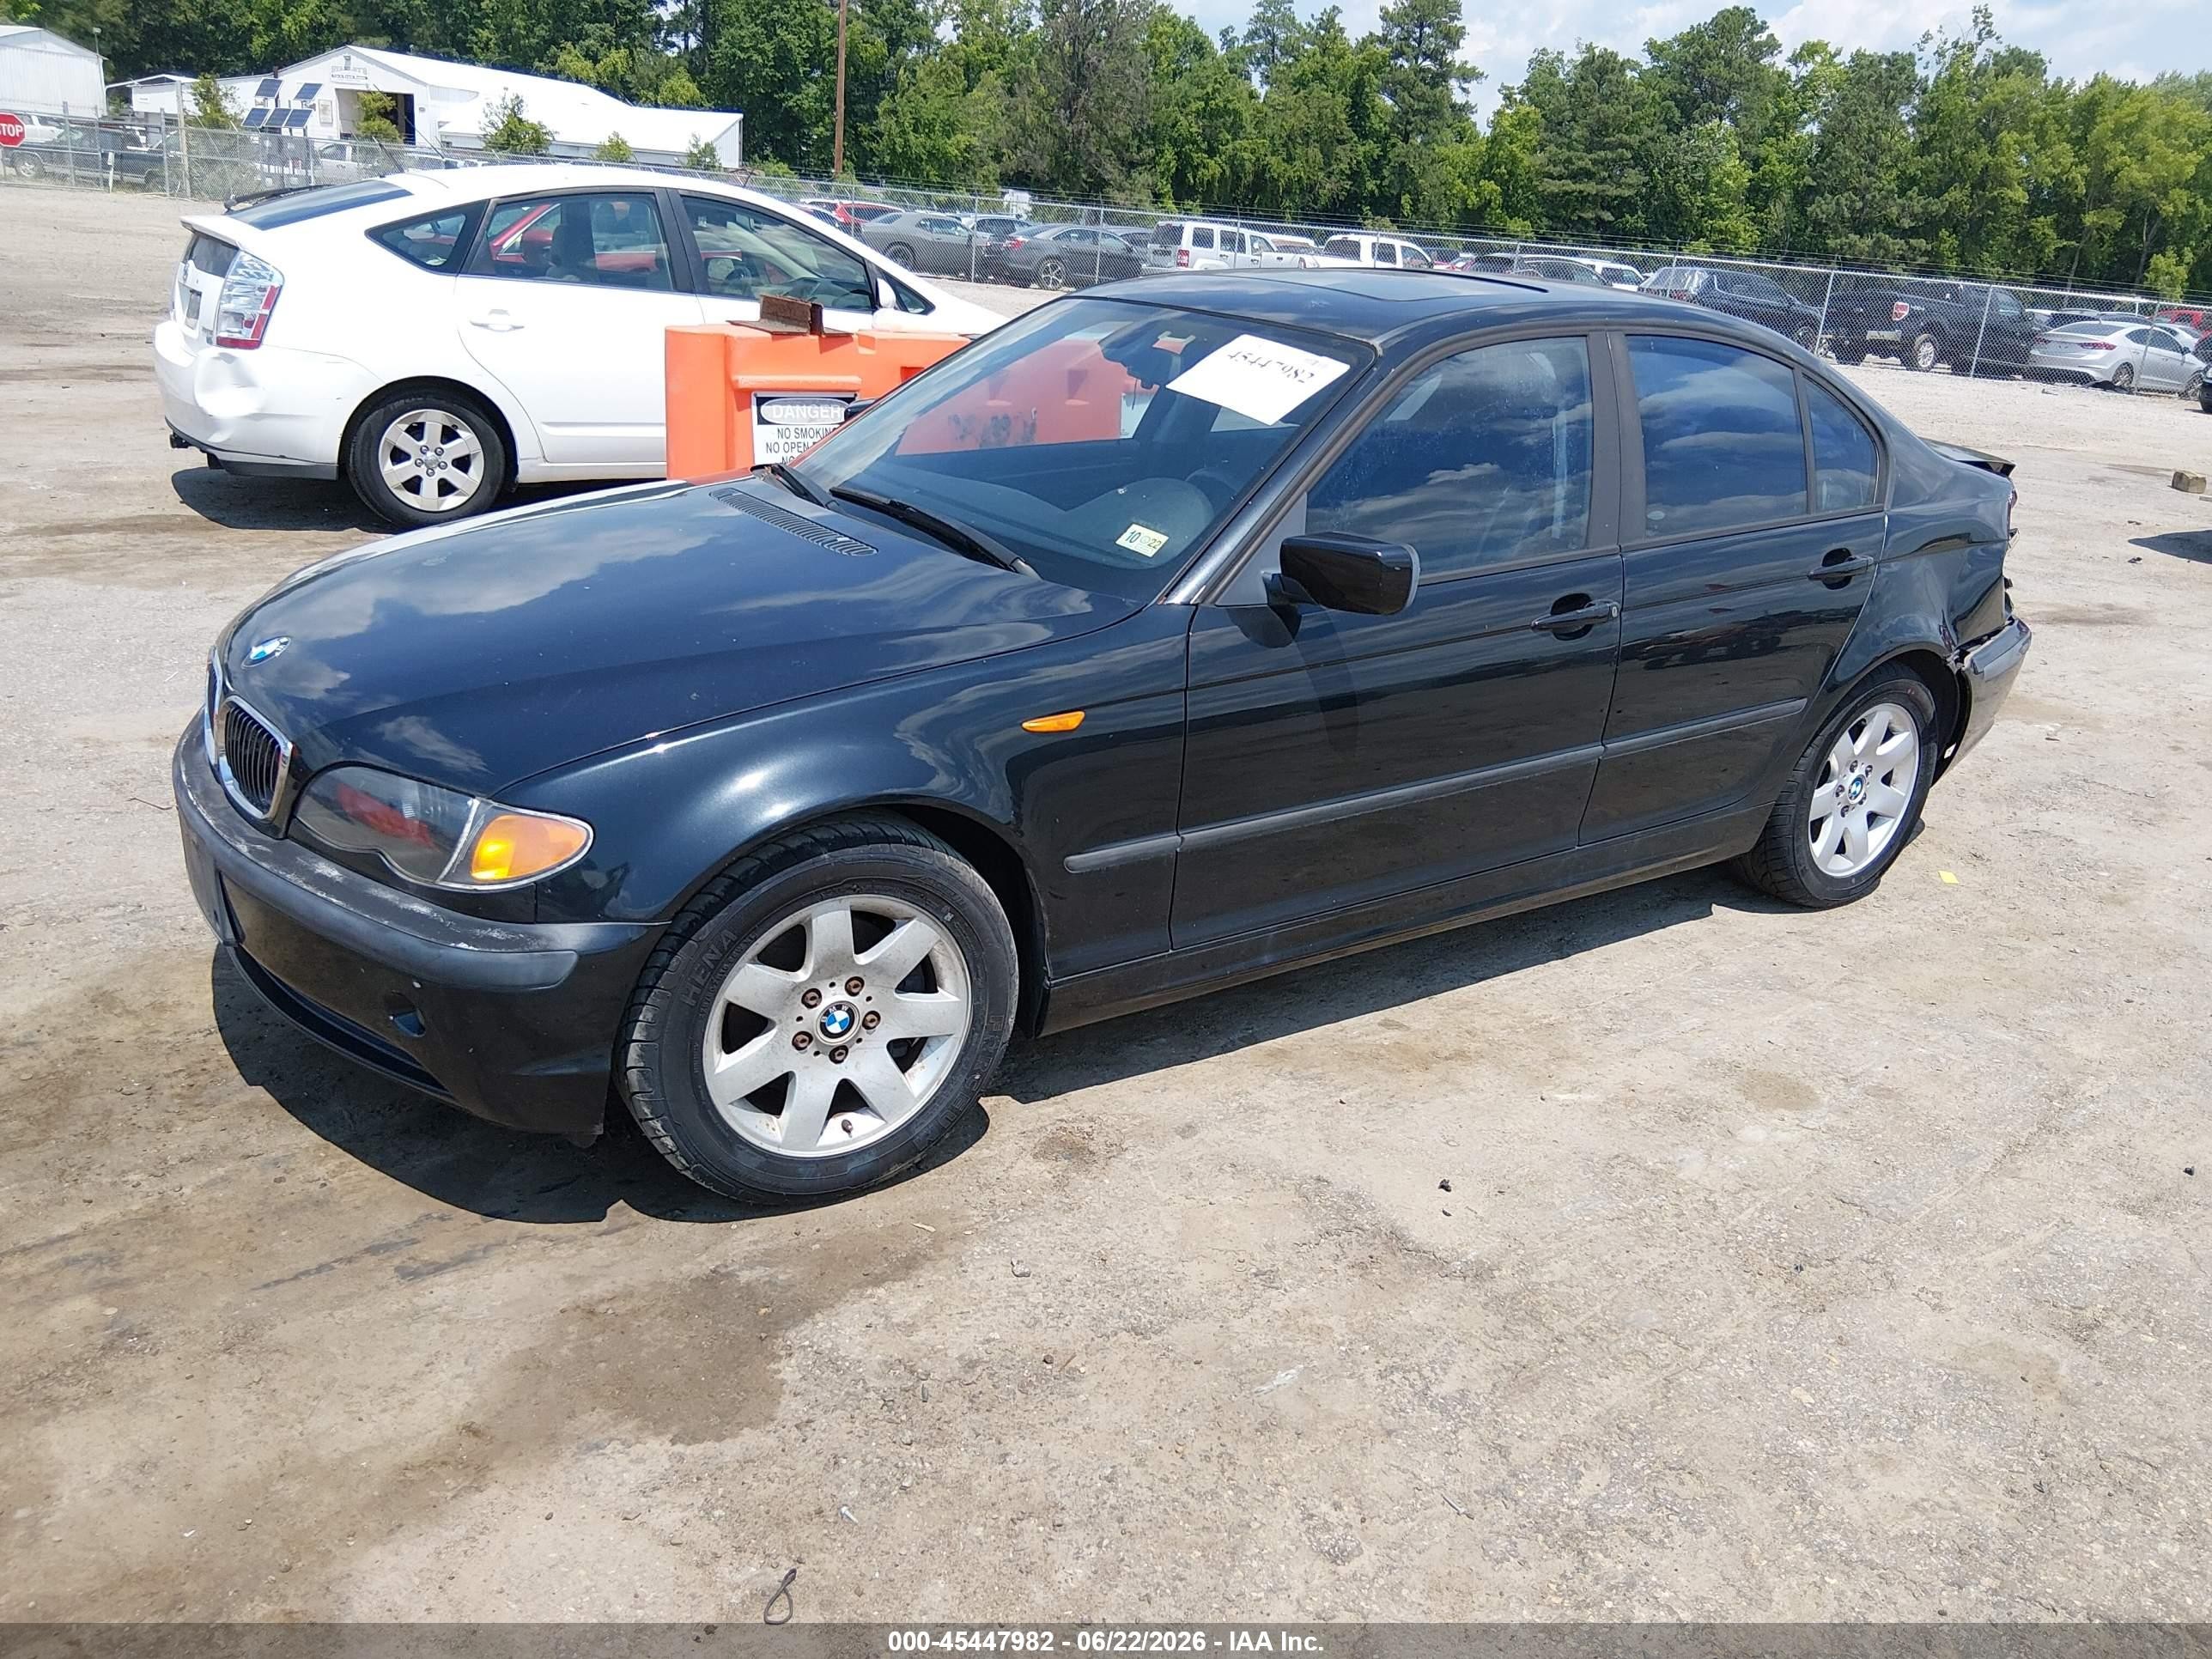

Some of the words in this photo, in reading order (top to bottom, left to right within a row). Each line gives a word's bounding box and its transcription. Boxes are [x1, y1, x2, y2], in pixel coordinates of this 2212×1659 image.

[0, 124, 23, 137] TOP
[773, 404, 841, 420] DANGER
[777, 427, 791, 439] NO
[793, 427, 836, 440] SMOKIN
[766, 442, 780, 453] NO
[782, 442, 809, 453] OPEN
[1125, 530, 1141, 544] 10
[1147, 538, 1162, 550] 22
[682, 930, 738, 1006] HENA
